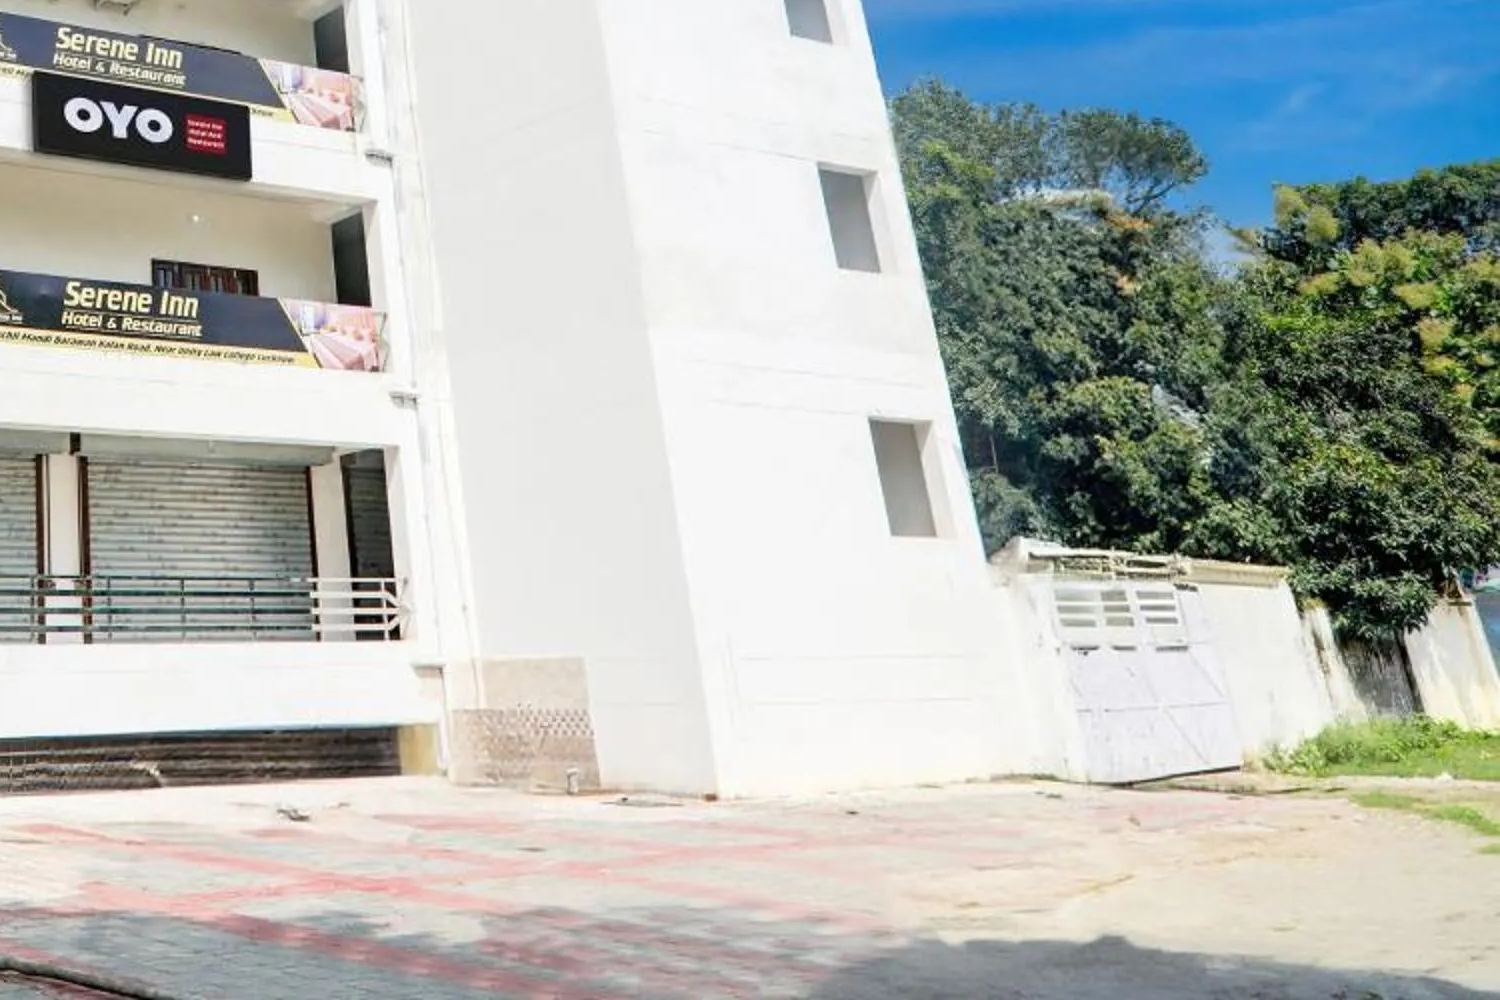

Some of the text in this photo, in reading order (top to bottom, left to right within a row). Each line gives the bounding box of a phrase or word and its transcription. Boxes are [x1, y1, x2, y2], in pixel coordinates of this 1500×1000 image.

[55, 26, 183, 69] Serene Inn
[52, 53, 187, 87] Hotel & Restaurant
[63, 96, 174, 144] OYO
[63, 281, 199, 318] Serene Inn
[61, 311, 202, 337] Hotel & Restaurant
